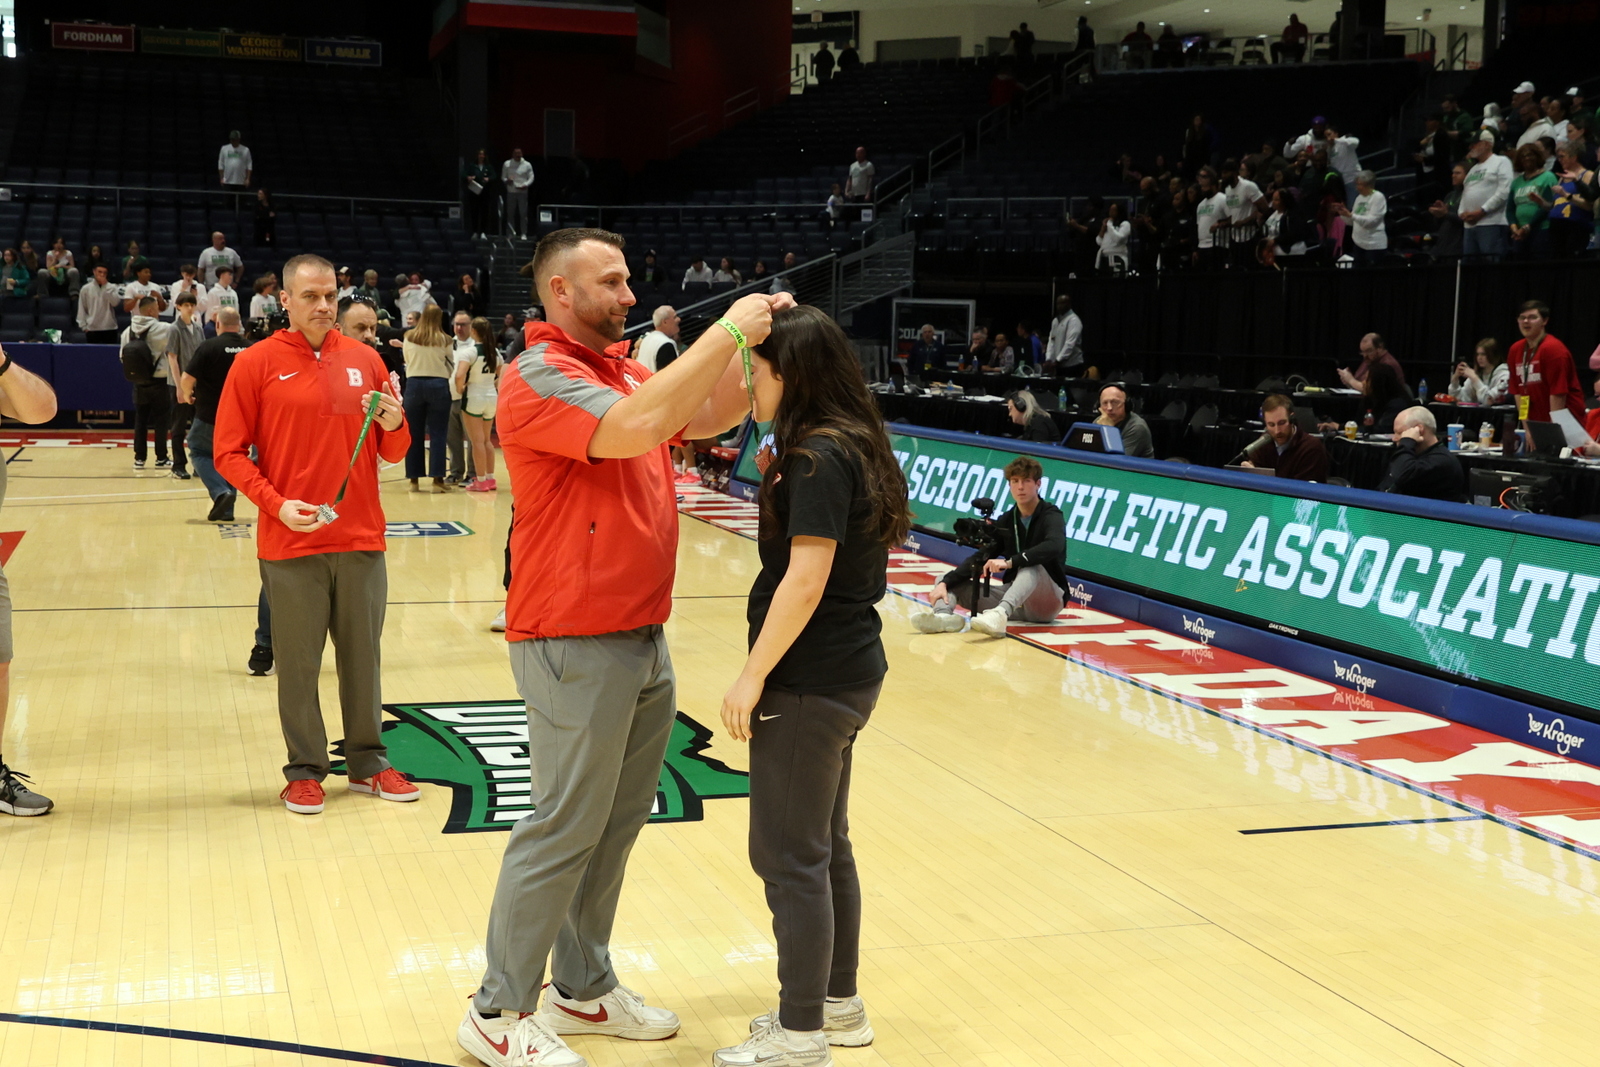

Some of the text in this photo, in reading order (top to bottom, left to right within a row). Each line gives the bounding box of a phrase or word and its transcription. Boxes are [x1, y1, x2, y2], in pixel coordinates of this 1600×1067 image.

[63, 31, 123, 44] FORDHAM
[239, 36, 284, 48] GEORGE
[227, 46, 298, 59] WASHINGTON
[315, 46, 332, 58] LA
[346, 367, 364, 387] B
[1081, 432, 1094, 444] POSS
[1074, 583, 1093, 607] Kroger
[1223, 514, 1600, 666] ASSOCIATI
[1192, 617, 1216, 644] Kroger
[1346, 663, 1376, 693] Kroger
[1542, 718, 1585, 755] Kroger
